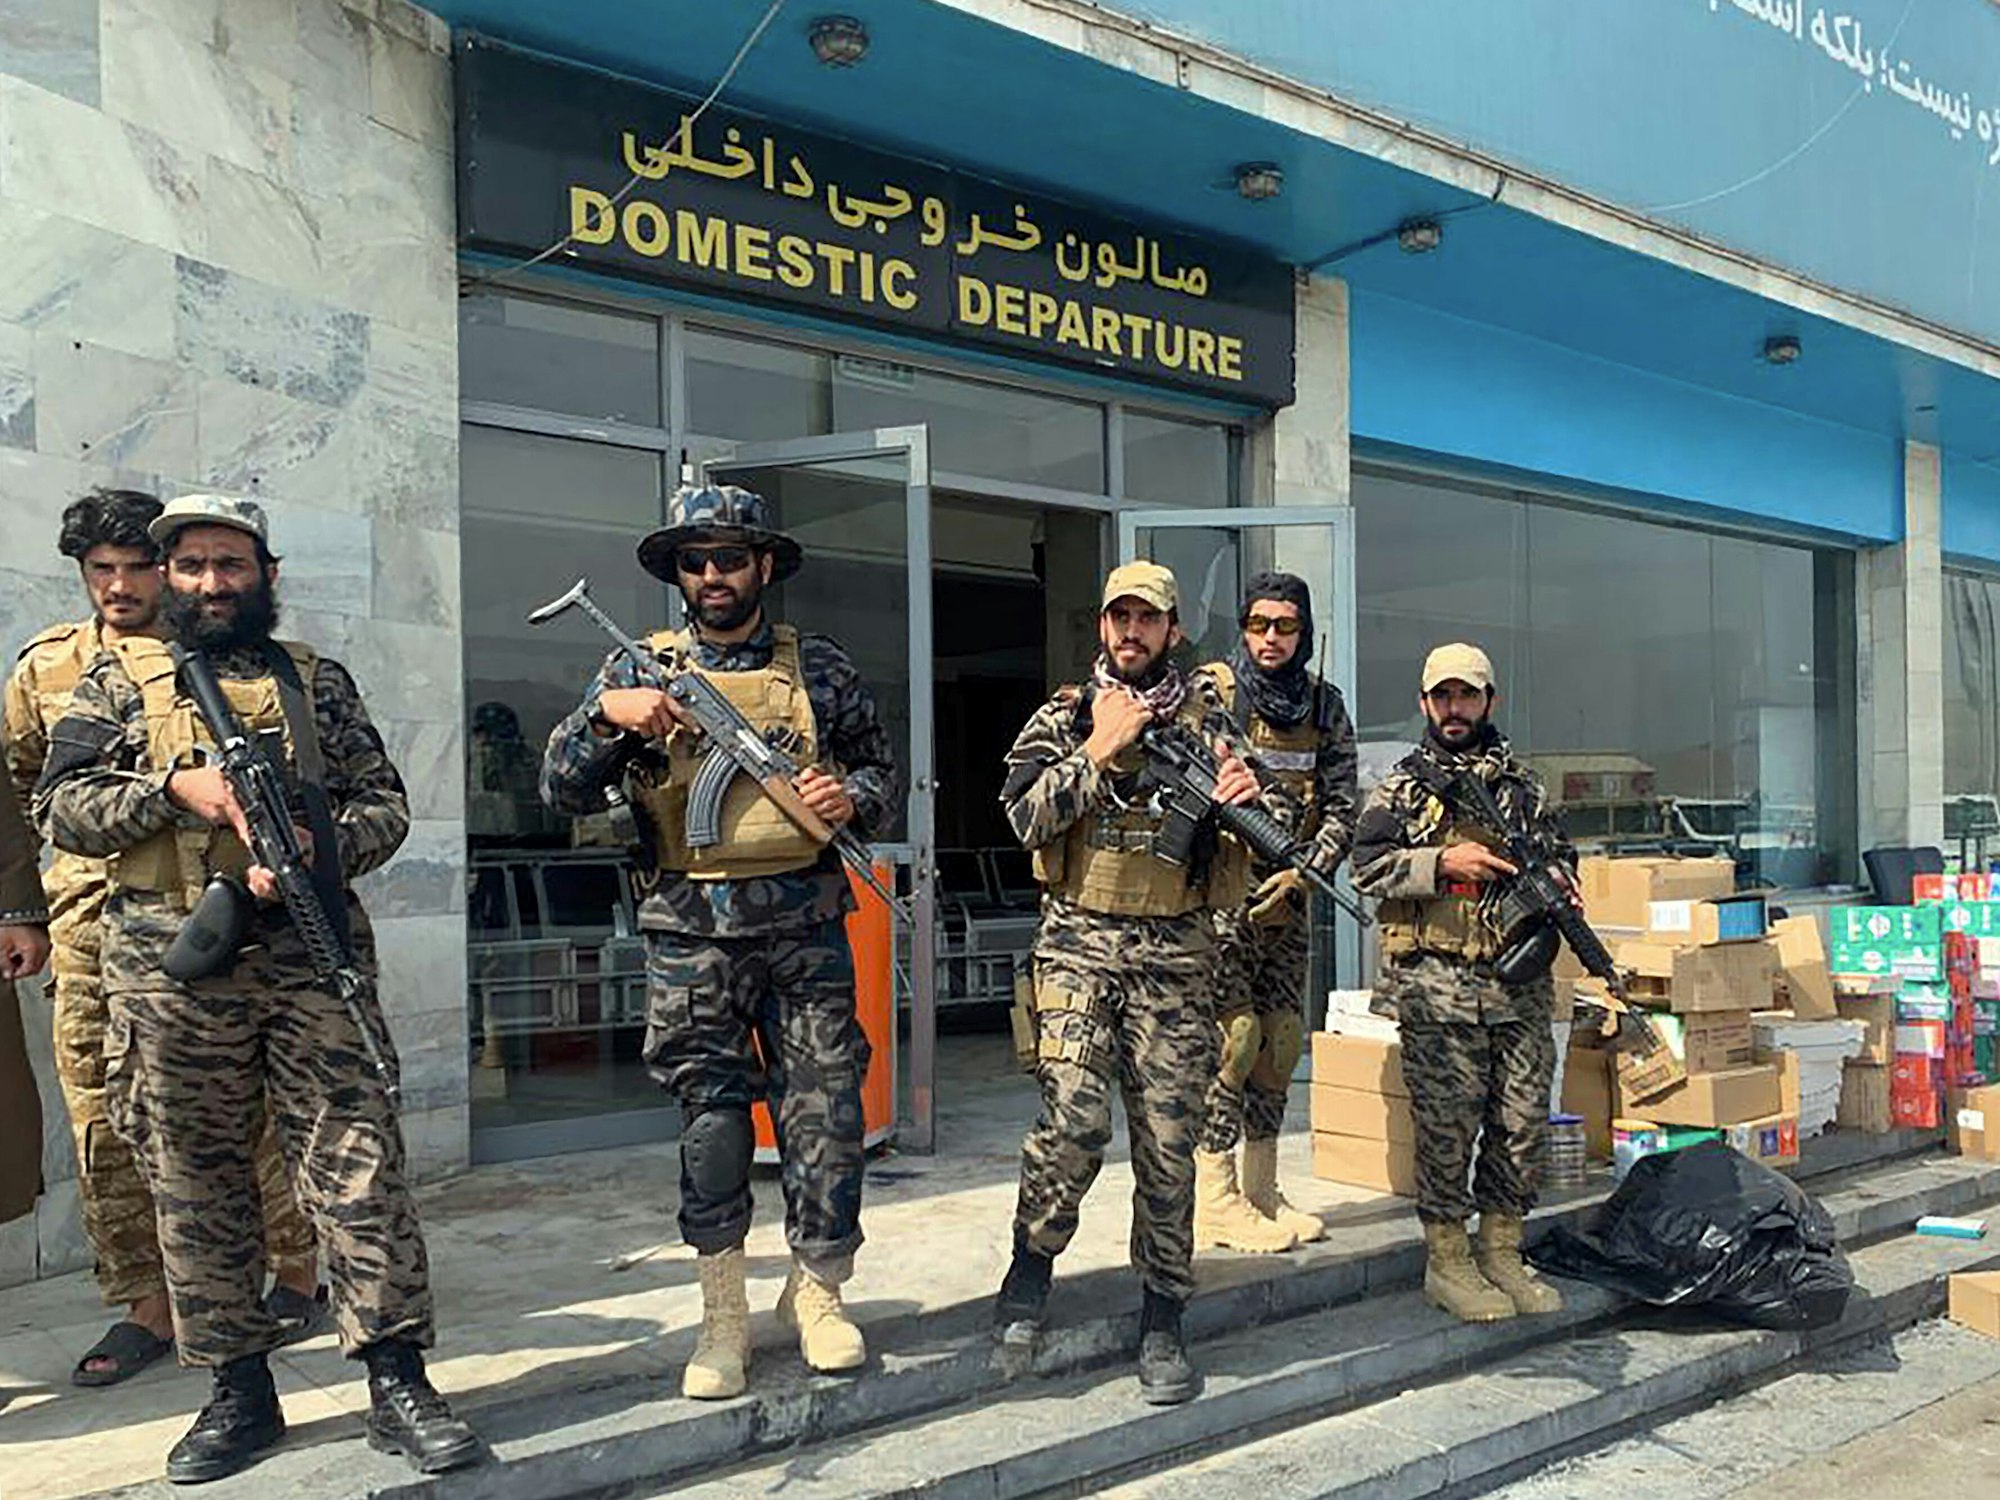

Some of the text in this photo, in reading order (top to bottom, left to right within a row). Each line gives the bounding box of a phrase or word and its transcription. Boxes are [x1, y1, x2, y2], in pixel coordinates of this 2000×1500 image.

[1810, 9, 1874, 92] بلکه
[623, 116, 815, 198] داخلی
[569, 187, 1243, 380] DOMESTIC DEPARTURE
[1056, 233, 1208, 295] صالون
